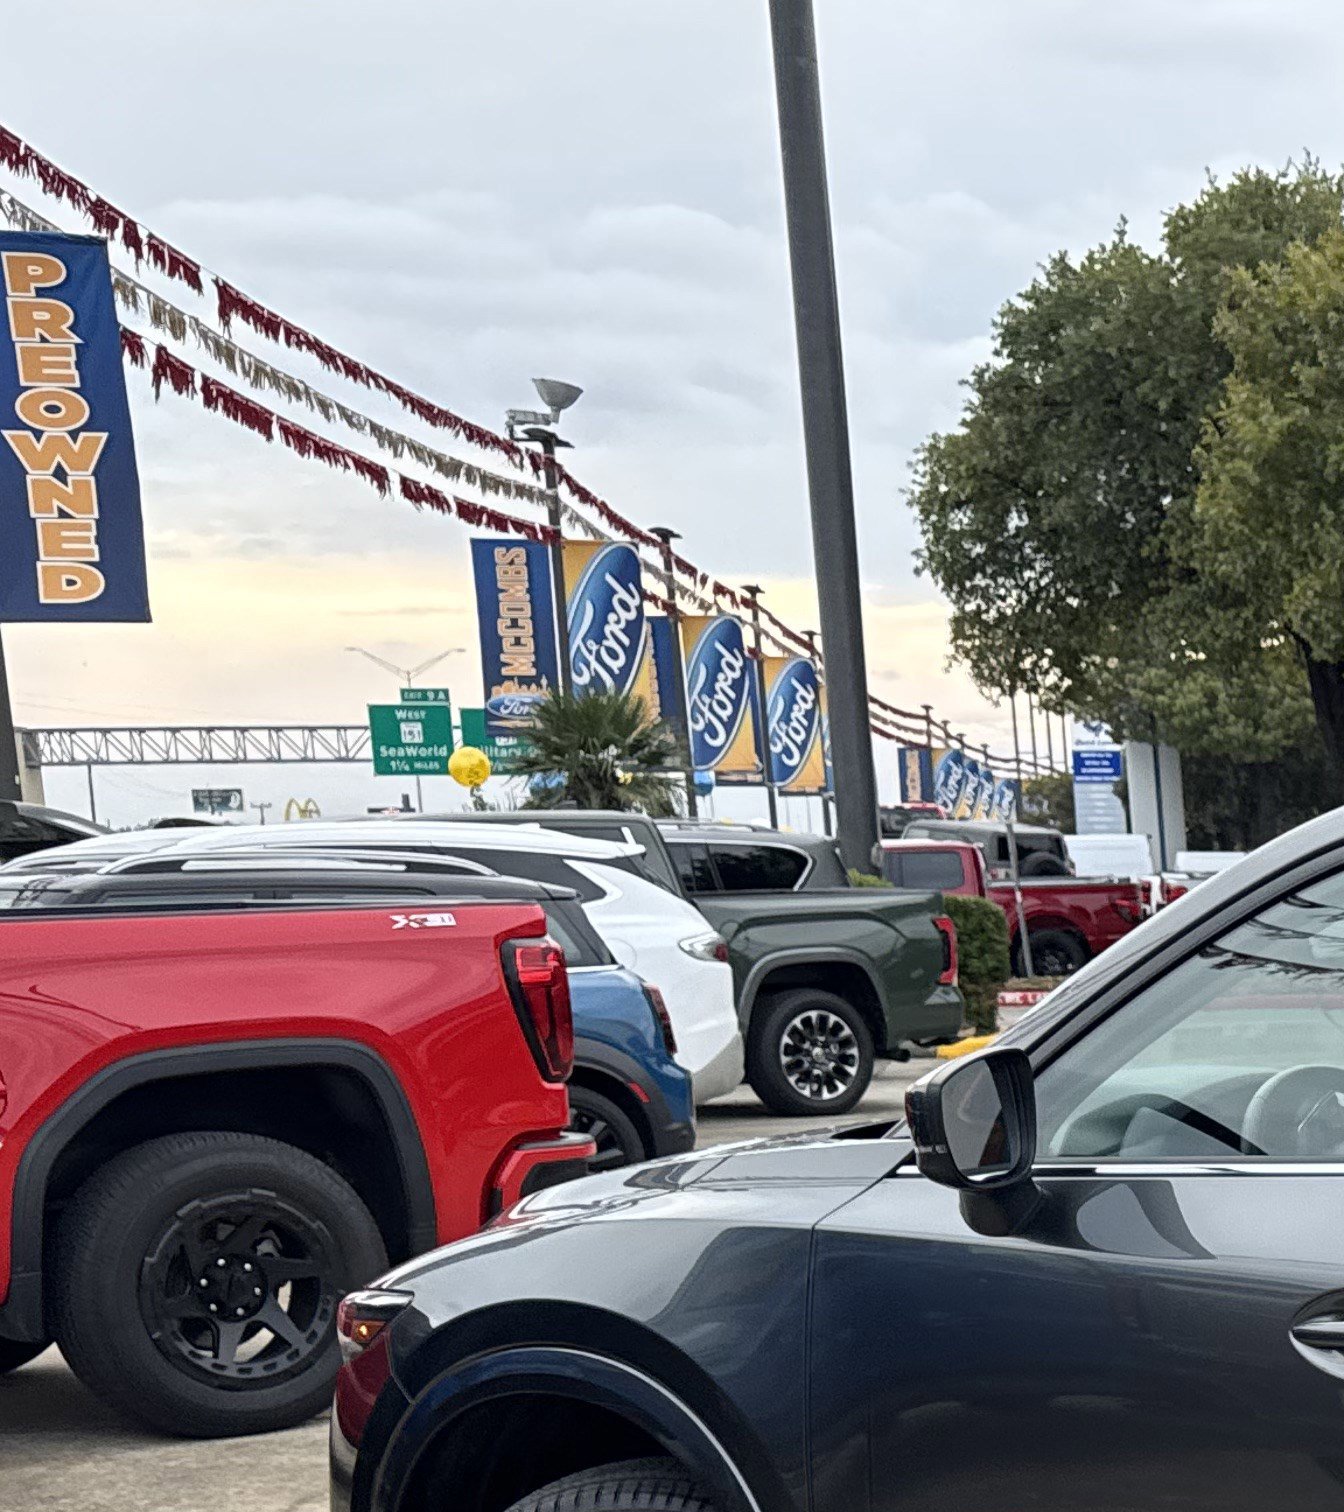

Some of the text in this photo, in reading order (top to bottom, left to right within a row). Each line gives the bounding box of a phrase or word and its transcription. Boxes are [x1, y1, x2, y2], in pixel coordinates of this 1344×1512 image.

[1, 251, 109, 604] PREOWNED
[494, 546, 536, 676] MCCOMBS
[571, 572, 641, 696] Ford
[380, 744, 447, 757] SeaWorld
[691, 640, 744, 748] Ford
[769, 677, 816, 768] Ford
